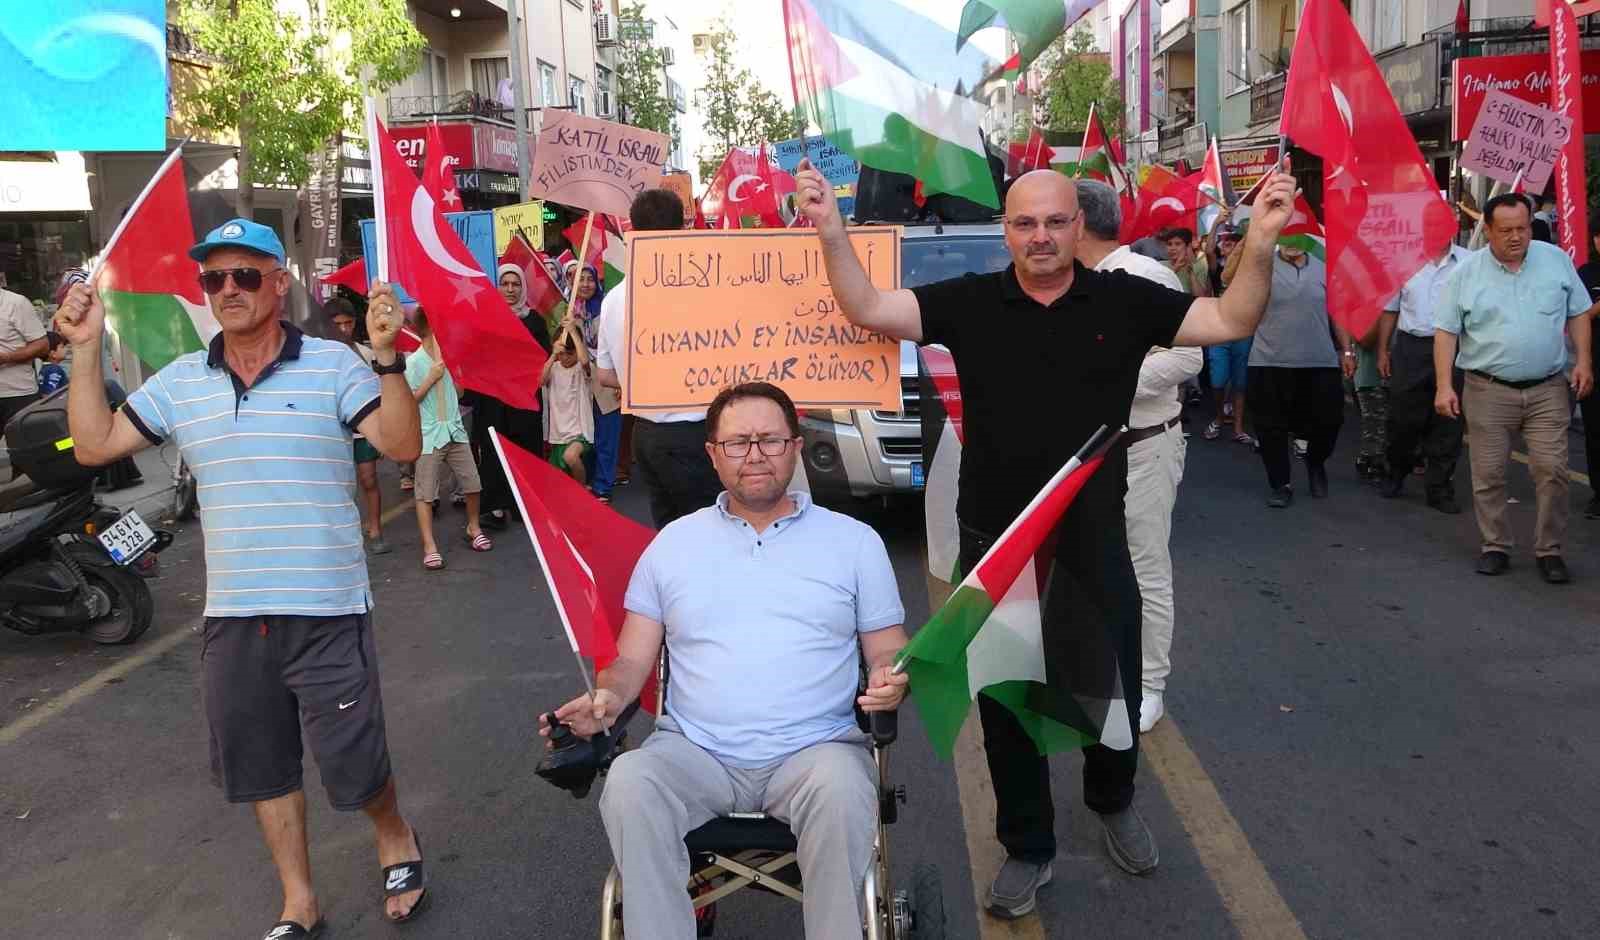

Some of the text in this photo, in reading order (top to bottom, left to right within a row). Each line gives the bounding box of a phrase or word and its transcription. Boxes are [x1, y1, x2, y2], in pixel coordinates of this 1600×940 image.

[1463, 73, 1520, 99] Italiano
[752, 325, 778, 348] EY
[684, 357, 798, 394] ÇOCUKLAR
[121, 530, 145, 552] 328
